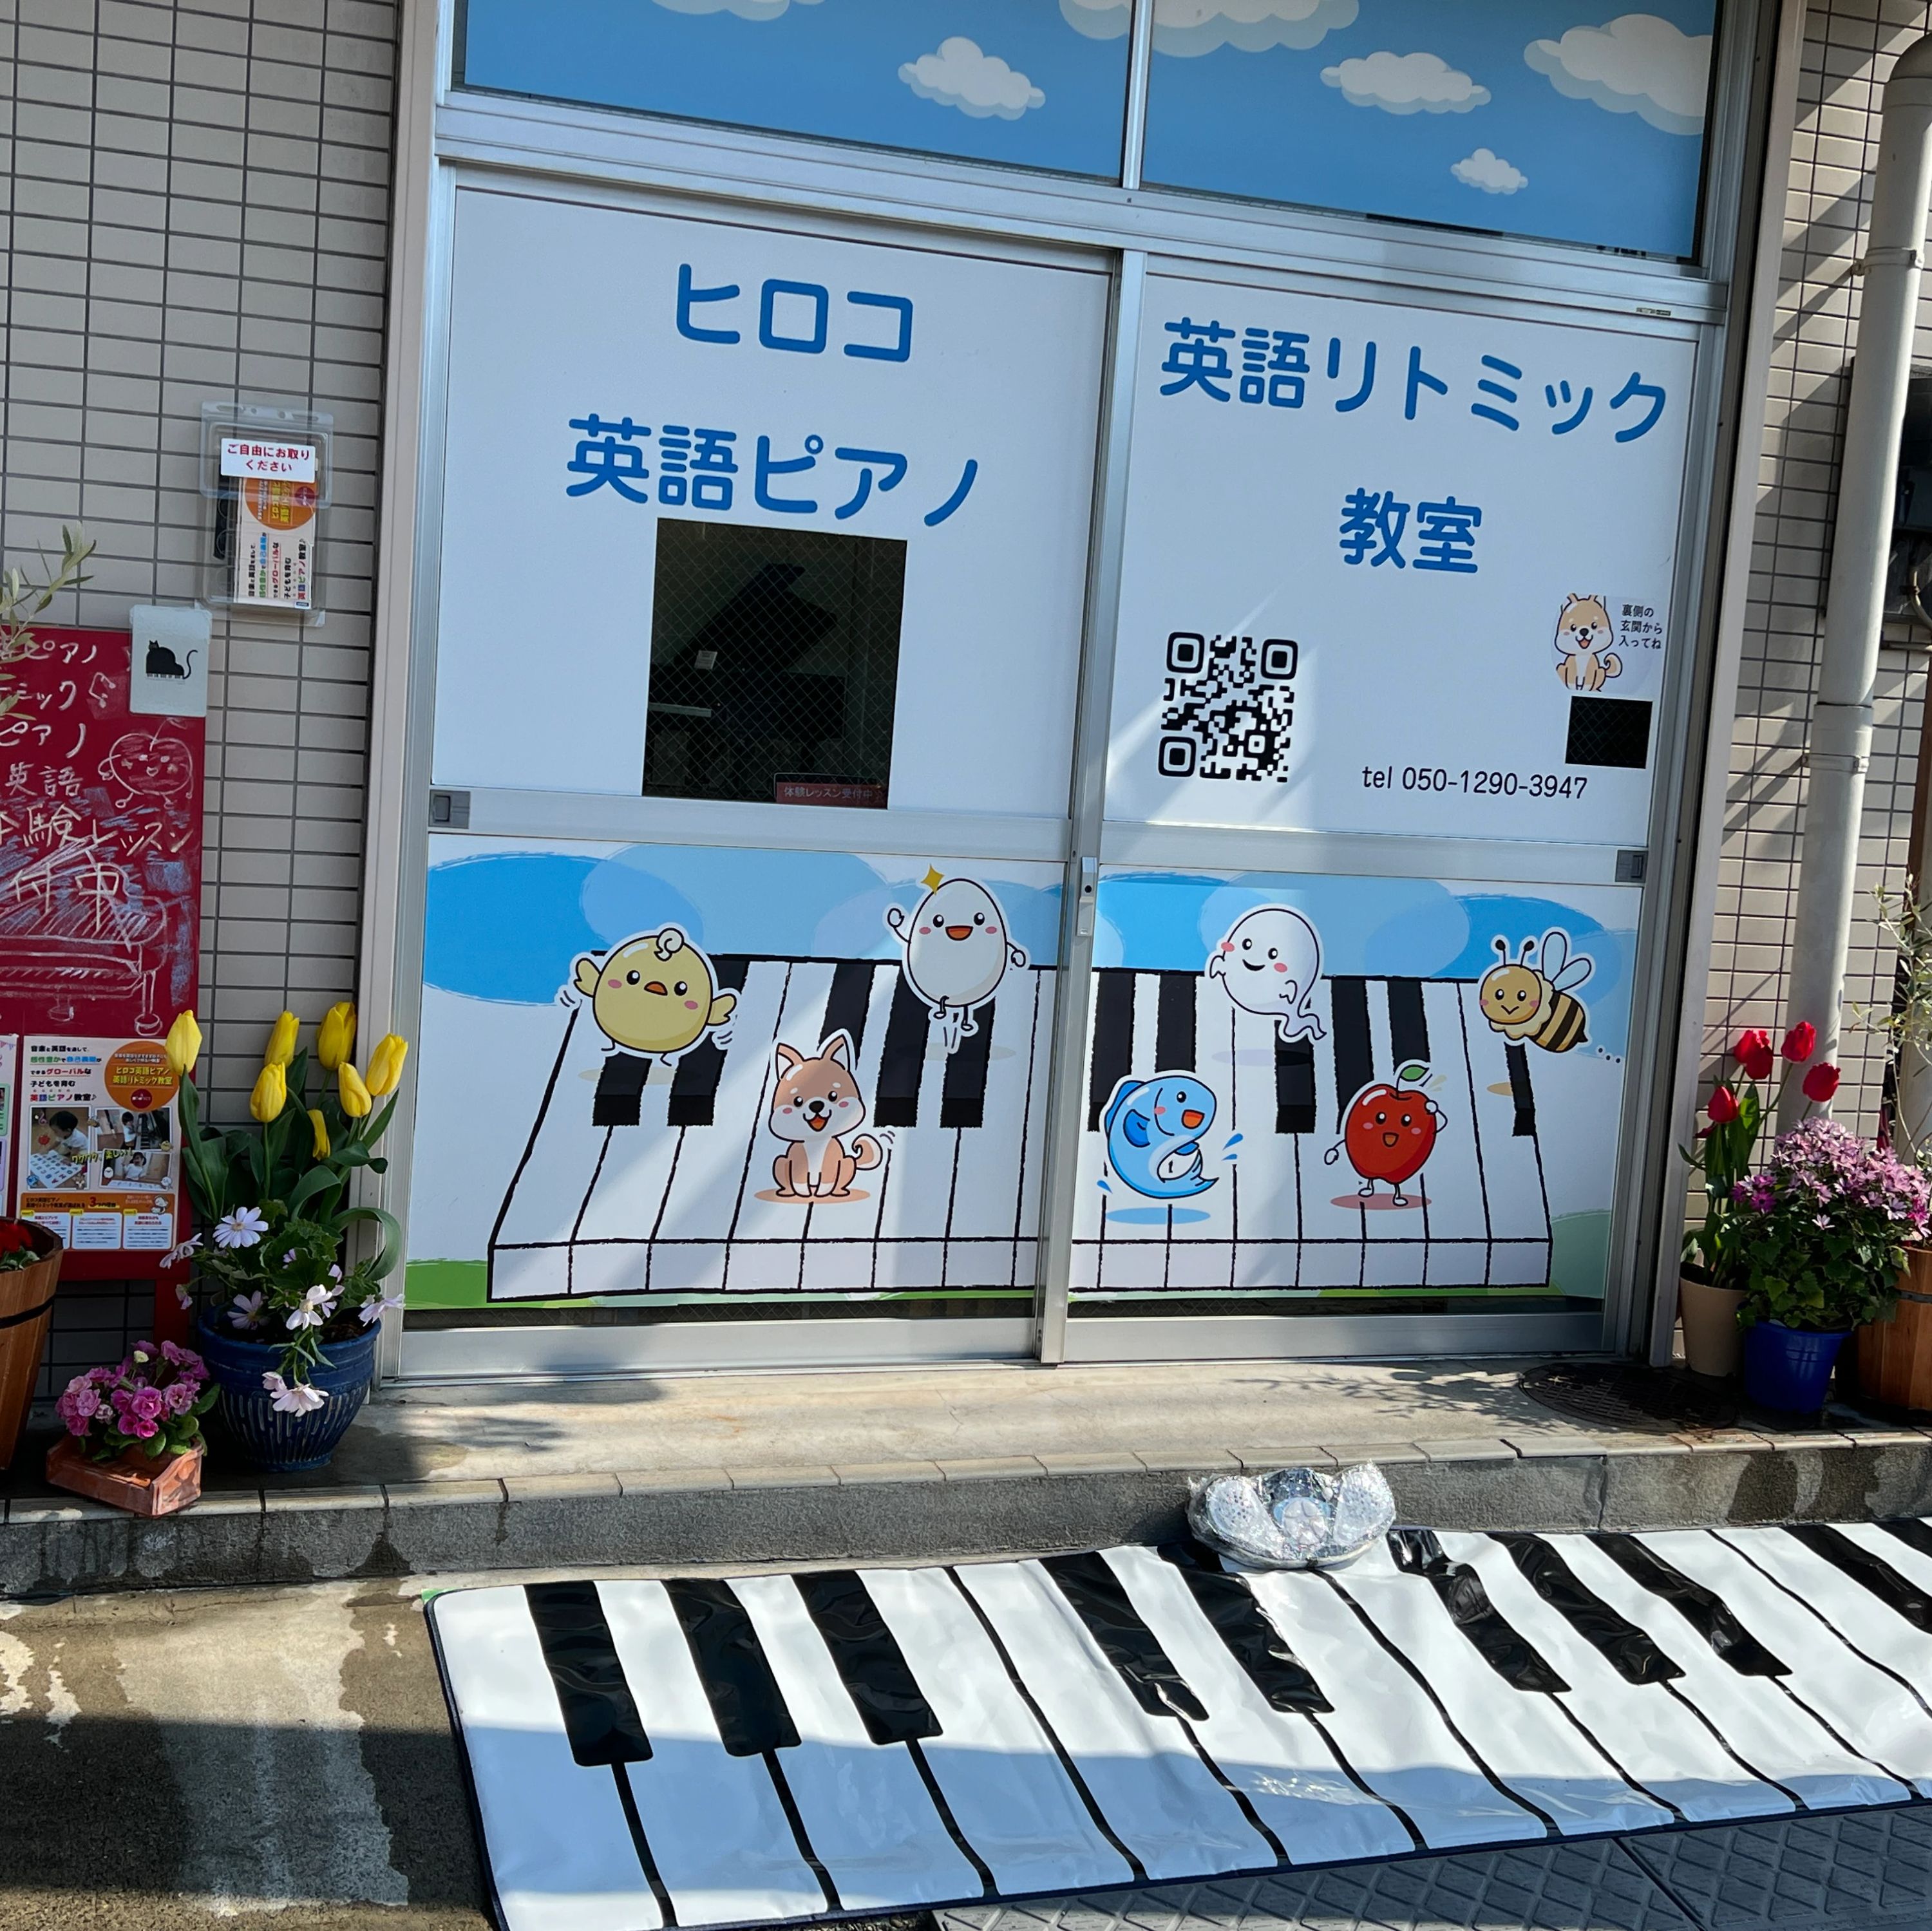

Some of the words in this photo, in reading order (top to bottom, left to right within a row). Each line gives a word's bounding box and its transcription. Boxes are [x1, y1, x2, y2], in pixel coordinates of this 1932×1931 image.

[677, 263, 913, 363] ヒロコ
[1160, 316, 1666, 443] 英語リトミック
[227, 444, 309, 460] ご自由にお取り
[246, 459, 292, 472] ください
[566, 413, 978, 527] 英語ピアノ
[1340, 487, 1482, 574] 教室
[1622, 604, 1654, 618] 裏側の
[1620, 620, 1663, 634] 玄関から
[1618, 635, 1662, 649] 入ってね
[5, 761, 82, 796] 英語
[1362, 766, 1392, 789] tel
[1402, 767, 1587, 799] 050-1290-3947
[784, 786, 873, 799] 体験レッスン受付中
